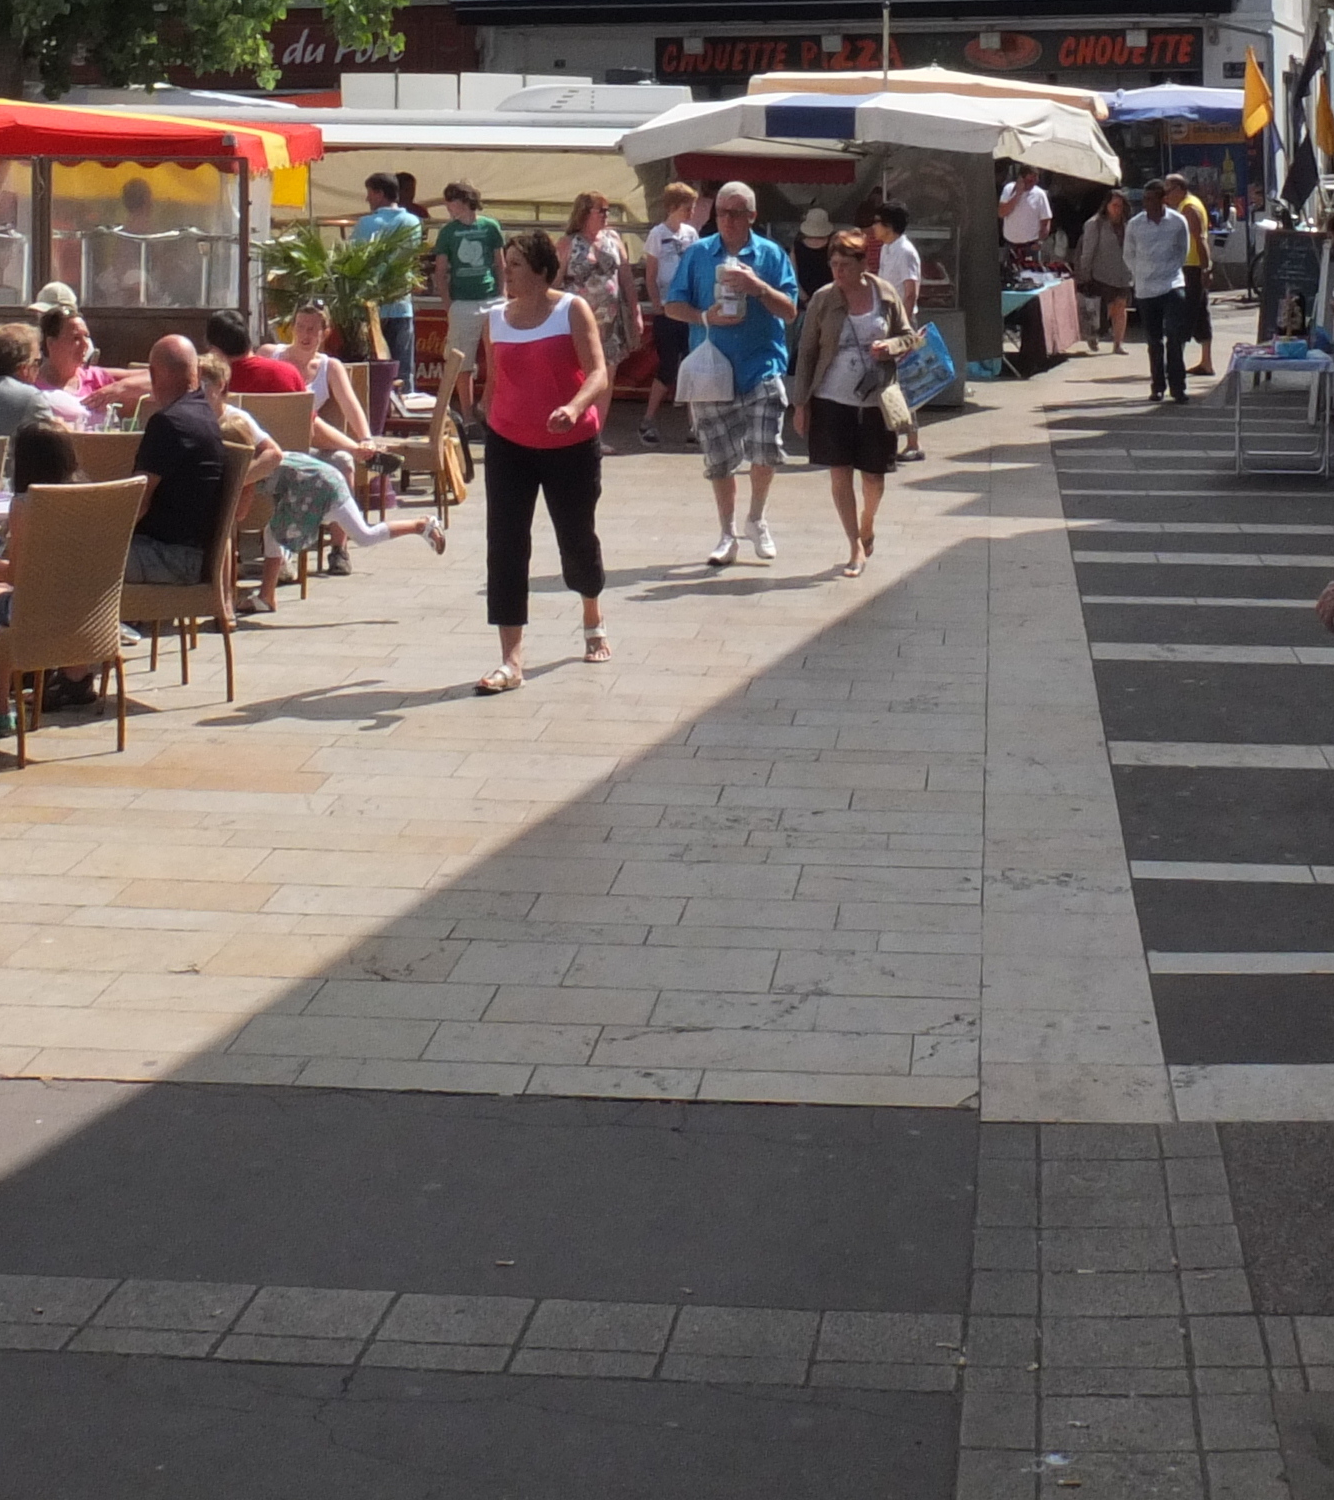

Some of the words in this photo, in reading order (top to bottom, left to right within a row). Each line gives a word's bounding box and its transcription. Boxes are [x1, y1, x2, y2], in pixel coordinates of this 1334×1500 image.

[281, 27, 327, 66] du
[661, 40, 788, 74] CHOUETTE
[800, 36, 904, 70] PIZZA
[1057, 33, 1195, 67] CHOUETTE
